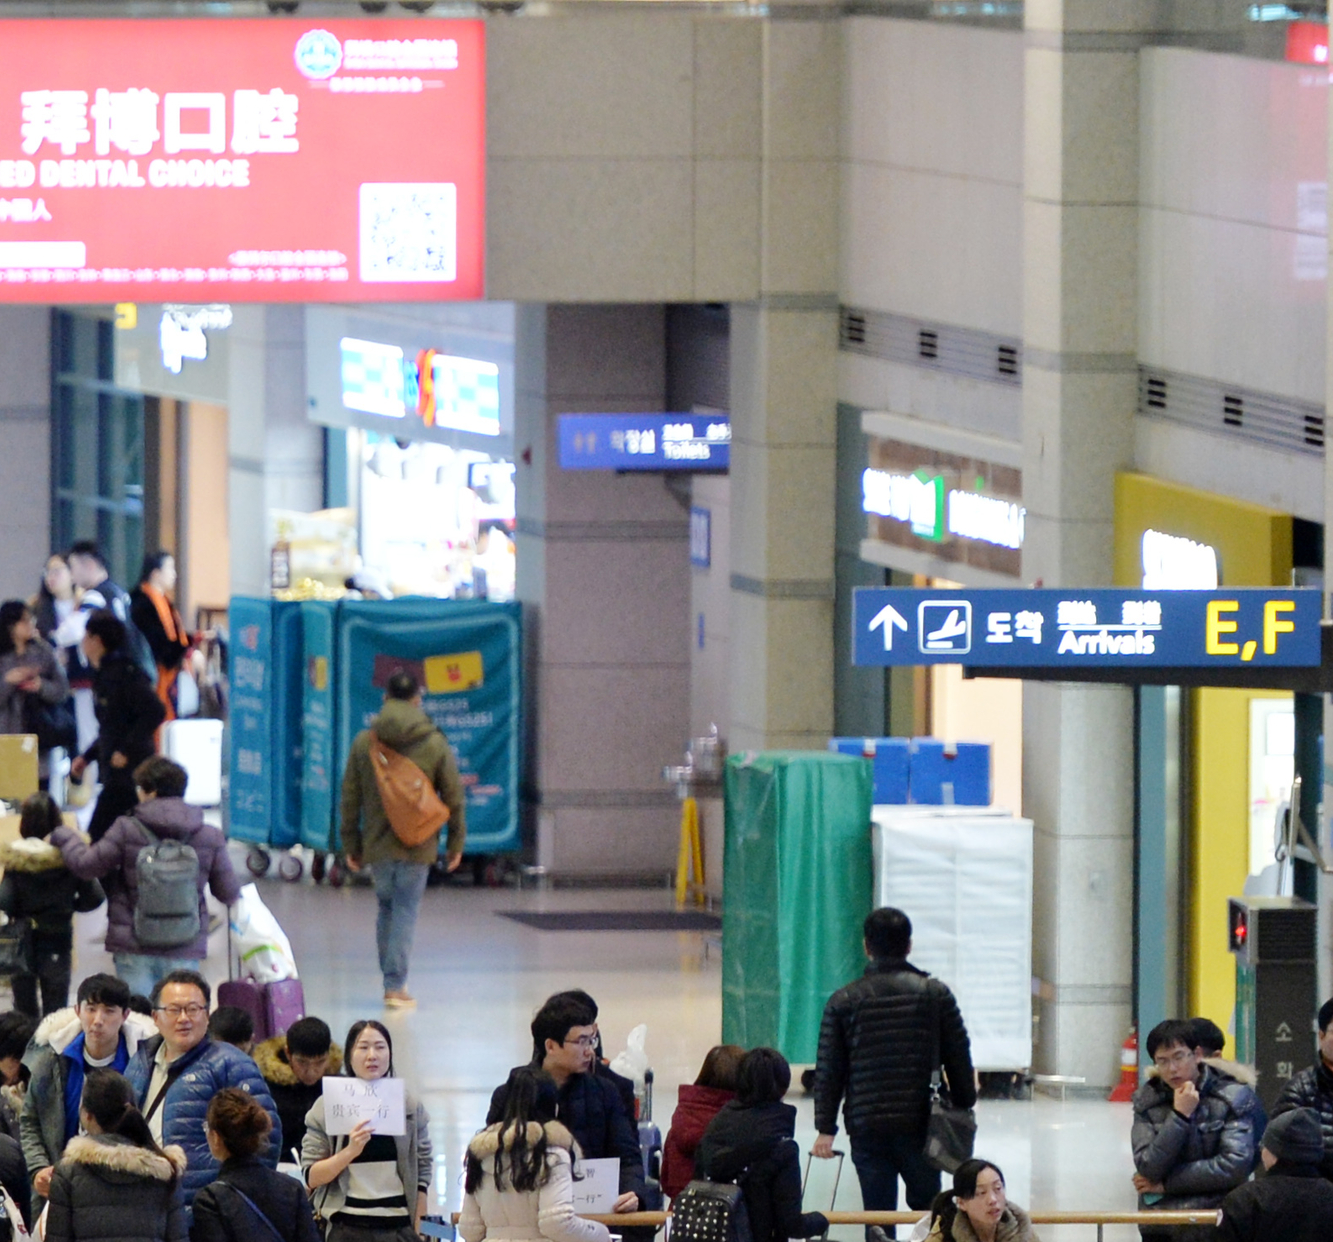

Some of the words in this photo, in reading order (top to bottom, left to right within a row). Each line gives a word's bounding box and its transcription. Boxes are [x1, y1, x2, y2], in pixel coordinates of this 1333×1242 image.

[20, 88, 300, 156] 拜博口腔
[40, 160, 146, 187] DENTAL
[148, 160, 251, 187] CHOICE
[985, 610, 1044, 645] 도착
[1205, 600, 1296, 662] E,F
[1057, 629, 1156, 656] Arrivals
